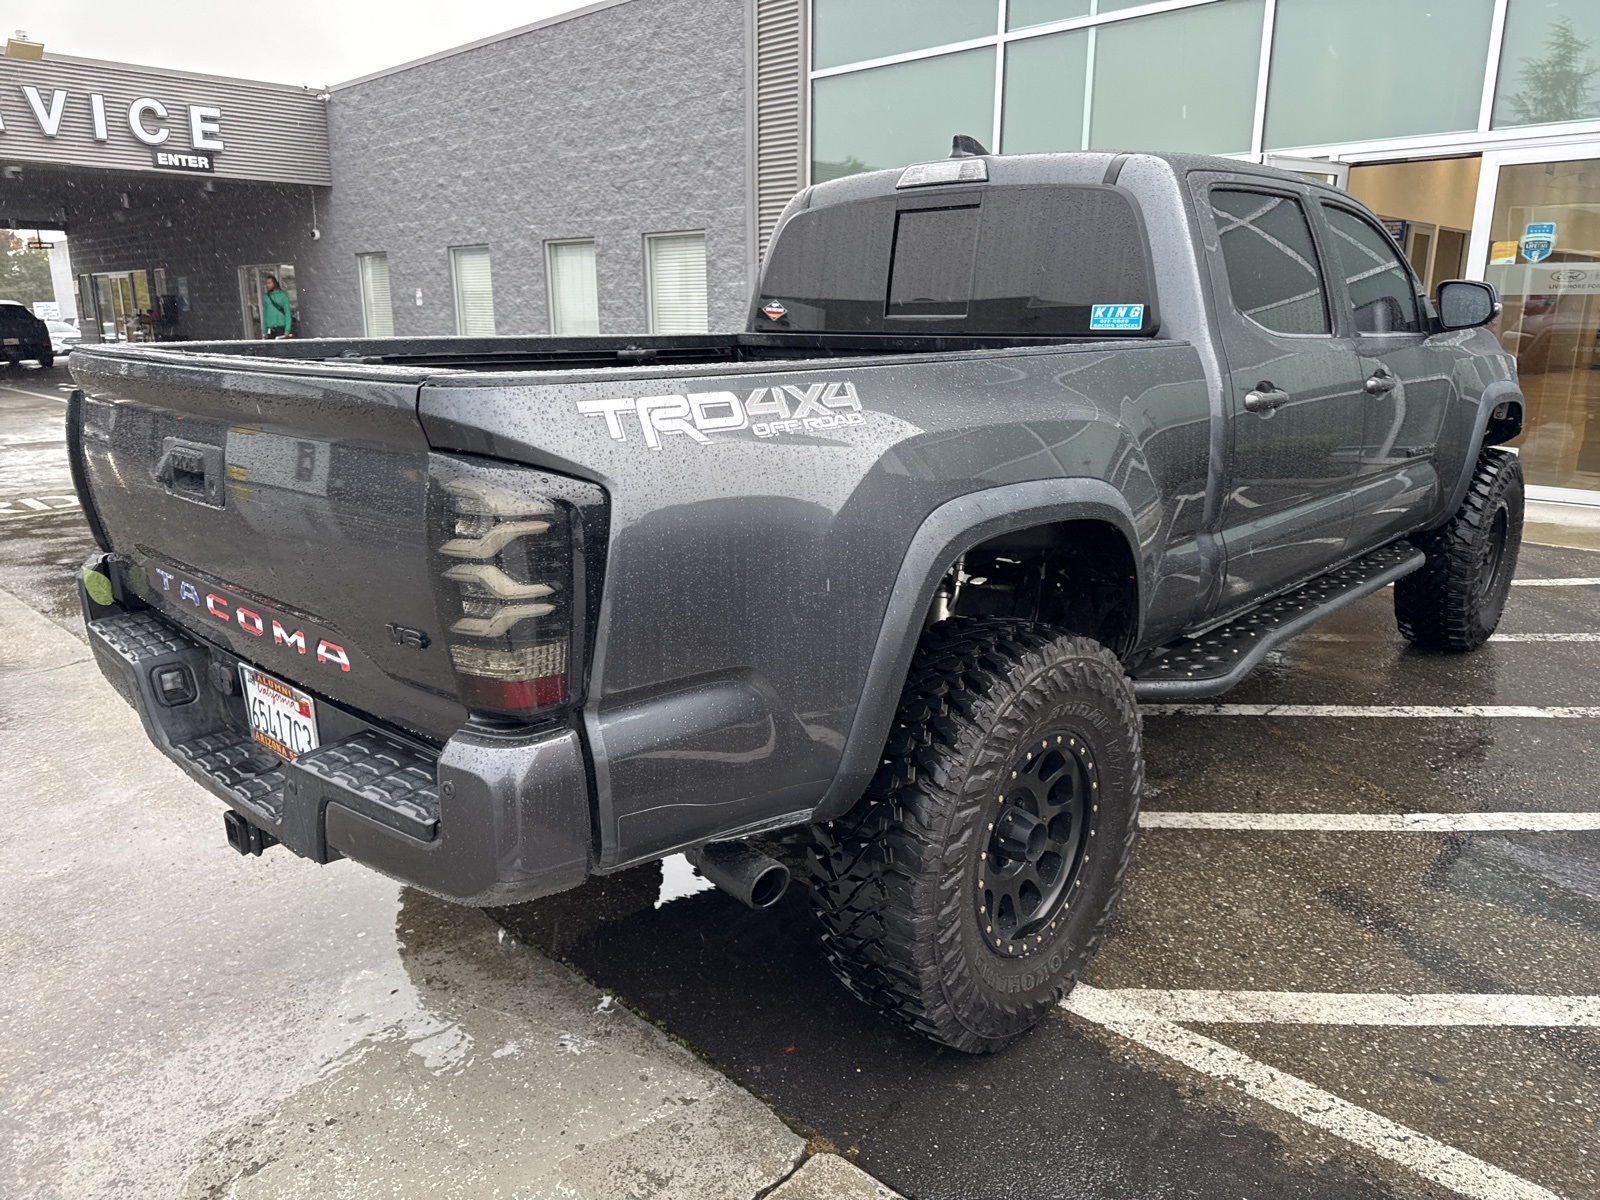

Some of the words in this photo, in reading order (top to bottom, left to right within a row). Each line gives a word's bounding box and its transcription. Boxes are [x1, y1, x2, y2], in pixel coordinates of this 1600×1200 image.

[0, 84, 225, 151] VICE
[157, 152, 210, 169] ENTER
[1094, 306, 1141, 318] KING
[576, 391, 748, 451] TRD
[156, 567, 351, 672] TACOMA
[385, 622, 432, 651] V6
[257, 675, 293, 698] ALUMNI
[257, 683, 295, 708] California
[255, 731, 288, 757] ARIZONA
